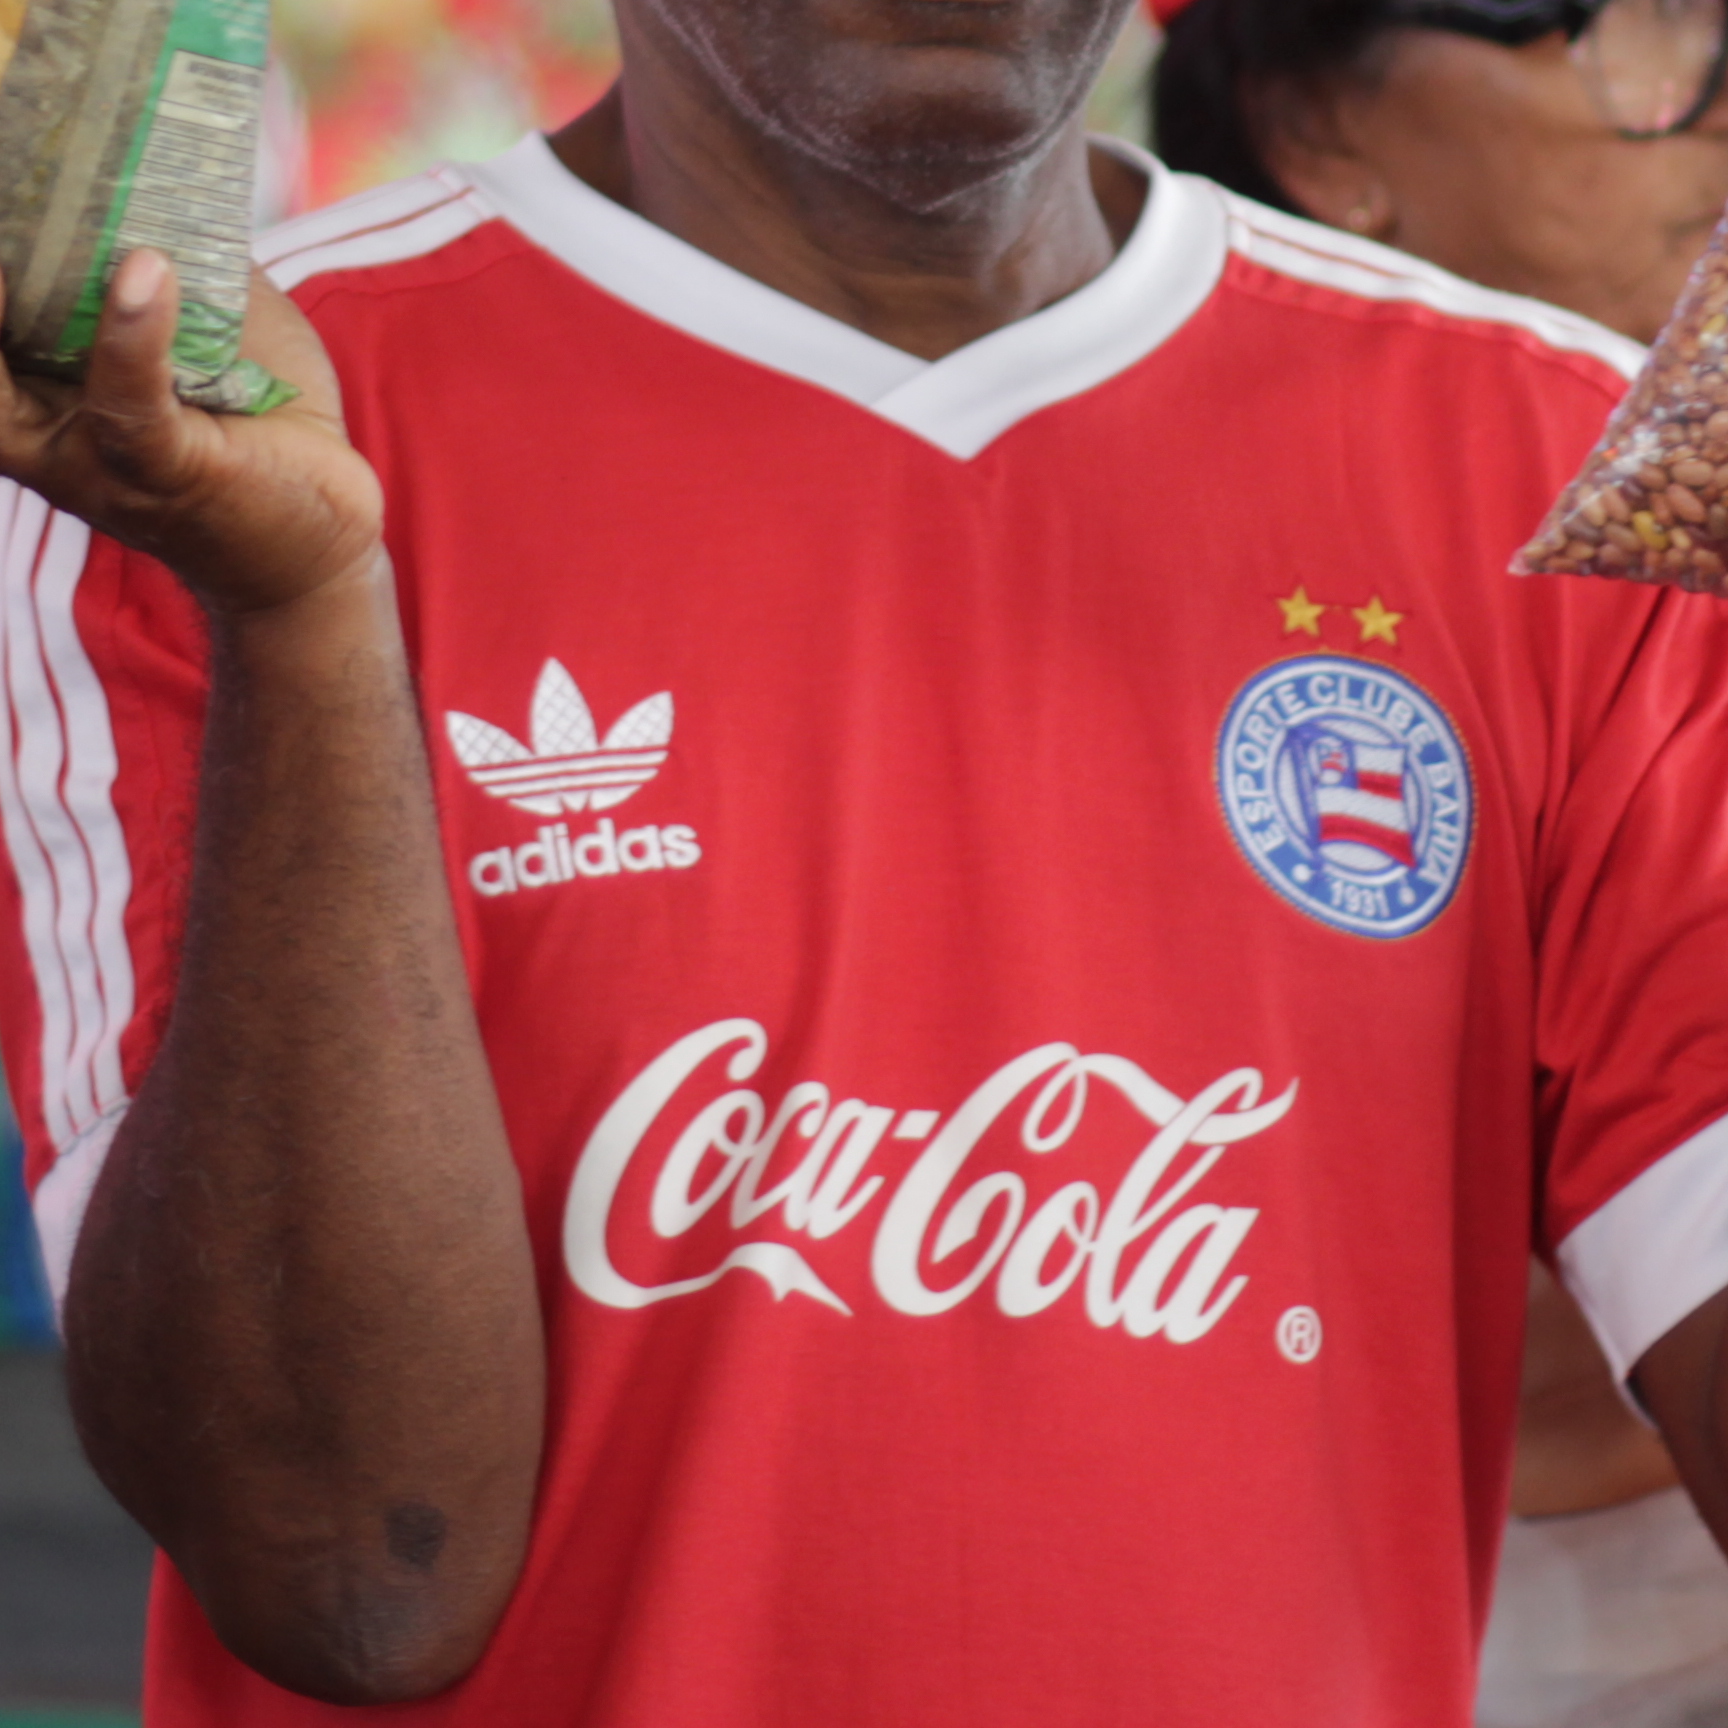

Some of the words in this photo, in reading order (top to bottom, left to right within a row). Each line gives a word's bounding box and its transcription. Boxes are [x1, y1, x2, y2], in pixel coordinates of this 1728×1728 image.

[1235, 682, 1307, 854] ESPORTE
[1306, 674, 1438, 757] CLUBE
[1416, 760, 1461, 885] BAHIA
[468, 817, 702, 898] adidas
[1329, 878, 1392, 919] 1931
[561, 1015, 1300, 1346] Coca-Cola
